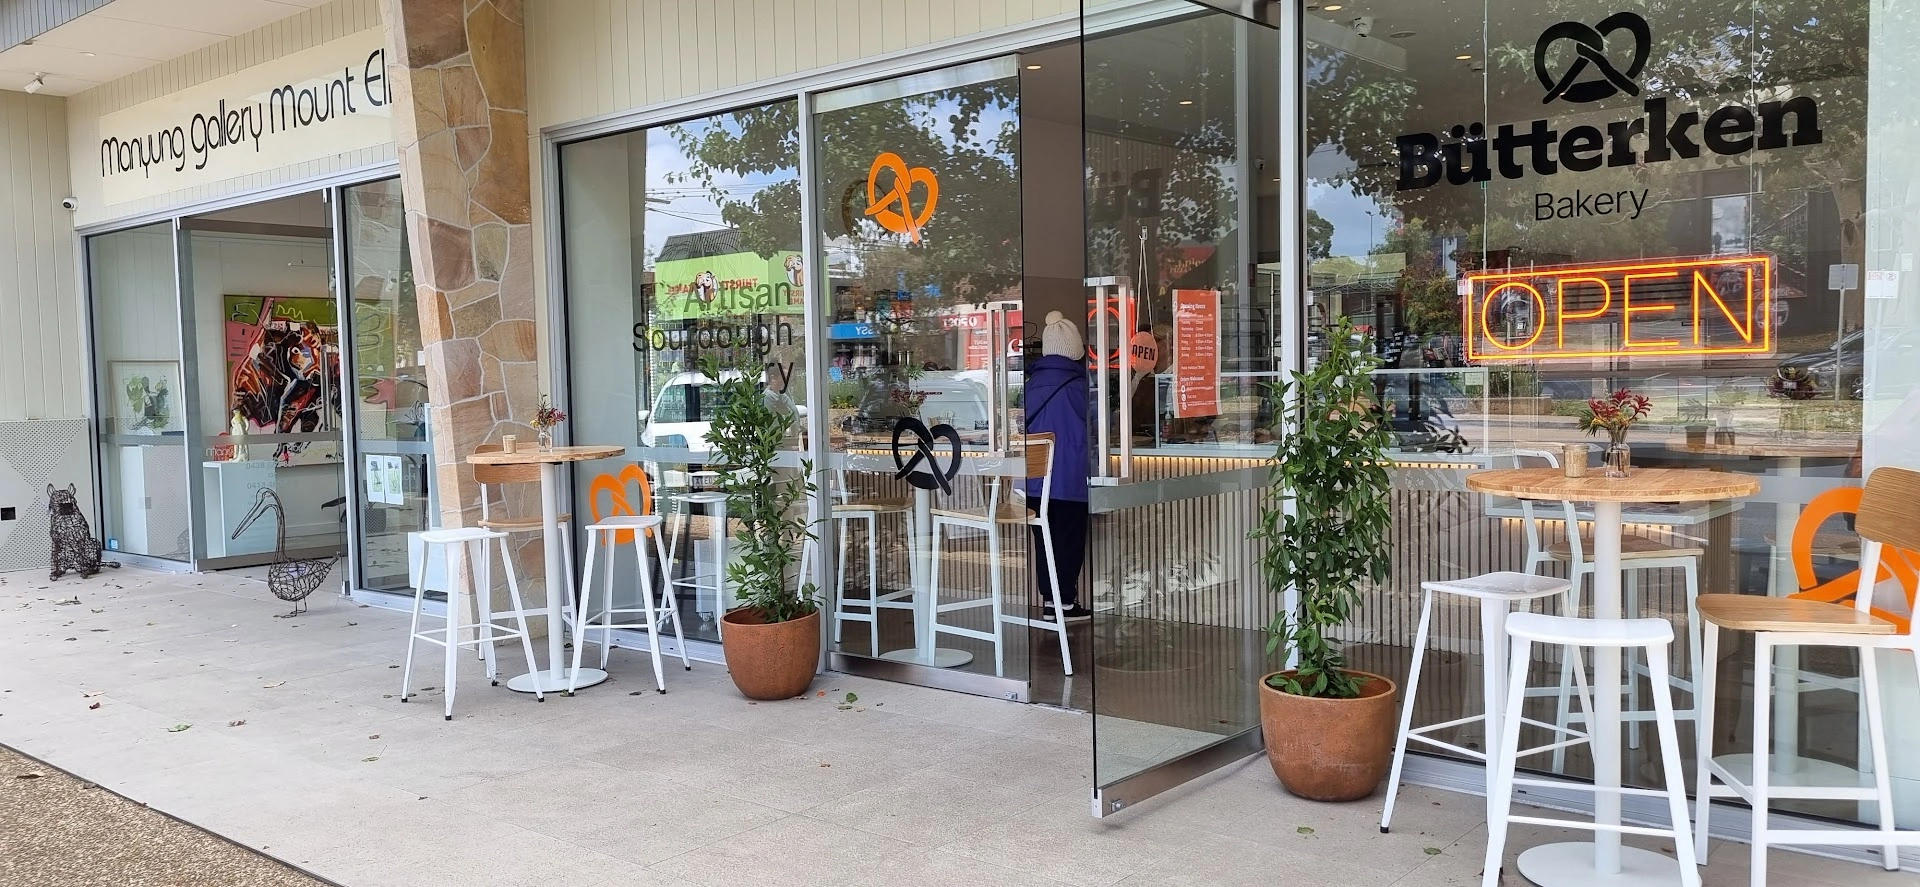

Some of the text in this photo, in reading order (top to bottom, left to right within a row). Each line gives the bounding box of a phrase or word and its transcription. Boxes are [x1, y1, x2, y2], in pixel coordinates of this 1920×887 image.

[270, 67, 356, 134] Mount
[1395, 96, 1823, 192] Bütterken
[1534, 188, 1649, 221] Bakery
[684, 281, 791, 313] Artisan
[1482, 267, 1753, 351] OPEN
[633, 314, 792, 356] Sourdough
[1132, 344, 1155, 361] OPEN
